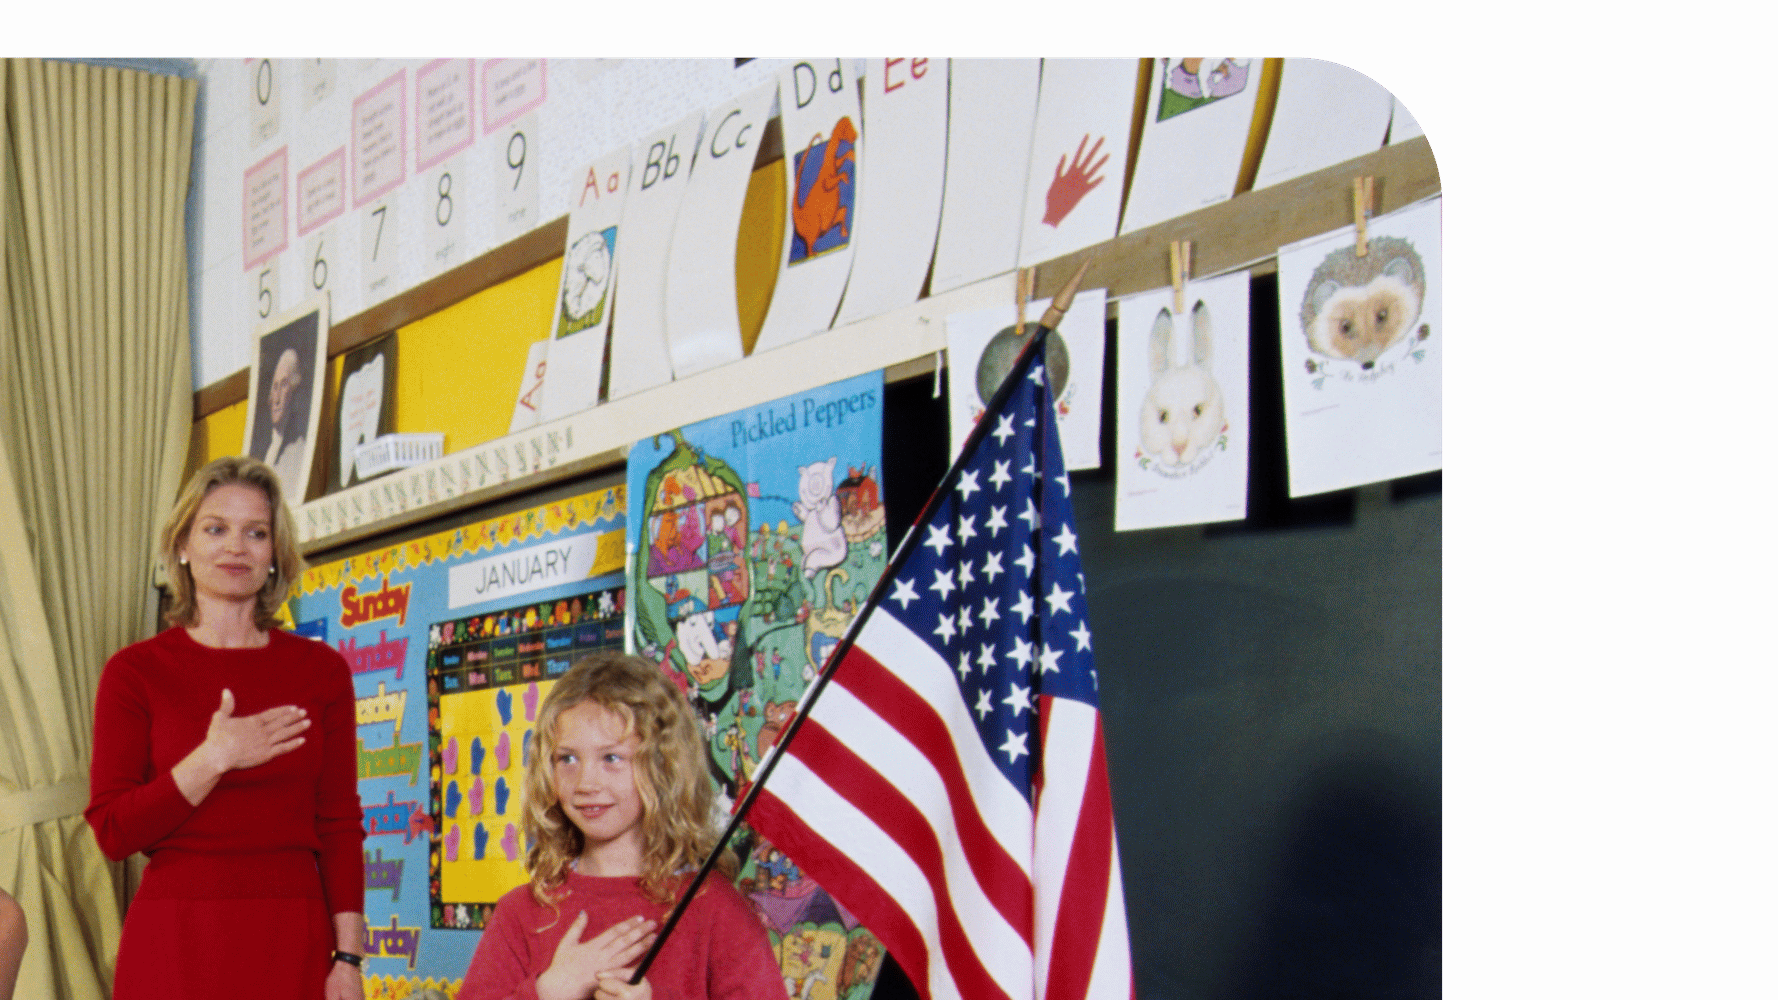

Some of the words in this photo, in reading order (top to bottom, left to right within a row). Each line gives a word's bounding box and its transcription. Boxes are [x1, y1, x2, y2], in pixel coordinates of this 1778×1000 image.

[256, 58, 273, 106] 0
[505, 131, 528, 192] 9
[435, 172, 454, 227] 8
[371, 204, 388, 263] 7
[312, 239, 329, 291] 6
[258, 268, 273, 320] 5
[730, 402, 798, 449] Pickled
[802, 388, 877, 429] Peppers
[474, 545, 573, 595] JANUARY
[340, 577, 412, 628] Sunday
